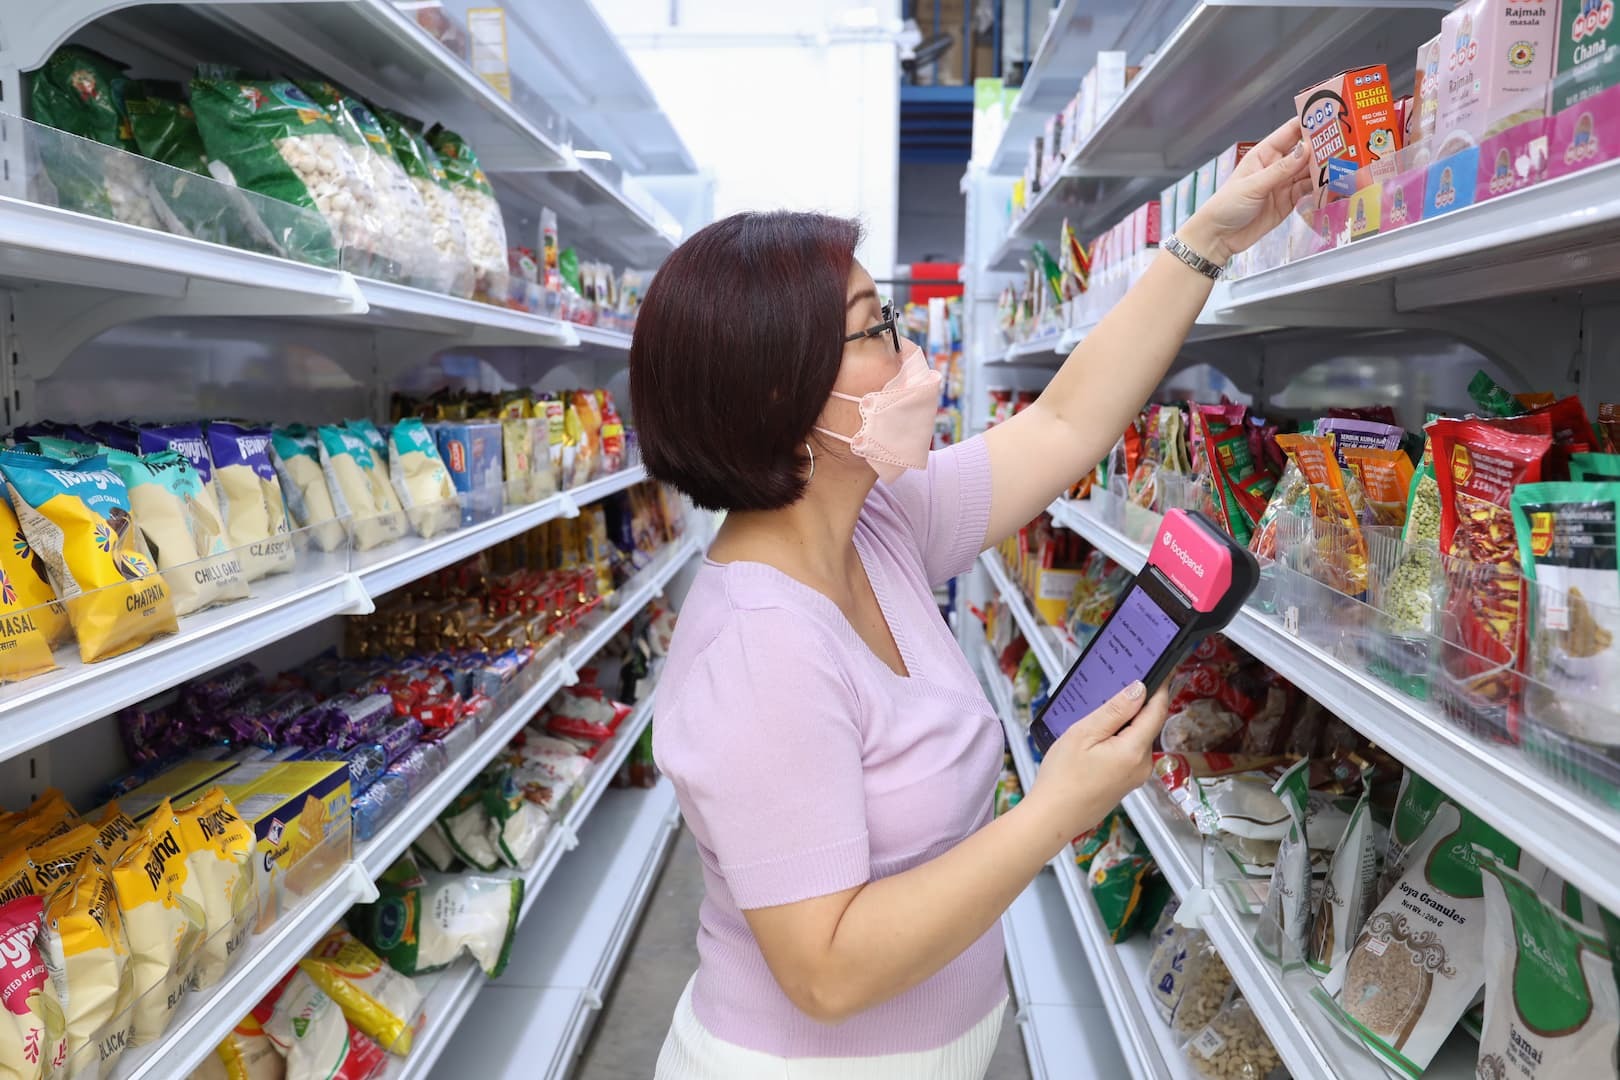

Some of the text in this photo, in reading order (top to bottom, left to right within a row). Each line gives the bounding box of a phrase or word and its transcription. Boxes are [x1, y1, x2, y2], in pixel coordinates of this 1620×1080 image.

[1505, 8, 1546, 18] Rajmah
[1509, 18, 1540, 26] masala
[1573, 38, 1606, 64] Chana
[1354, 86, 1386, 100] DEGGI
[1356, 95, 1388, 110] MIRCH
[1306, 102, 1333, 129] MDH
[1312, 121, 1339, 149] DEGGI
[1315, 136, 1343, 163] MIRCH
[1170, 539, 1205, 578] foodpanda
[126, 584, 165, 612] CHATPATA
[1399, 881, 1466, 925] Soya Granules
